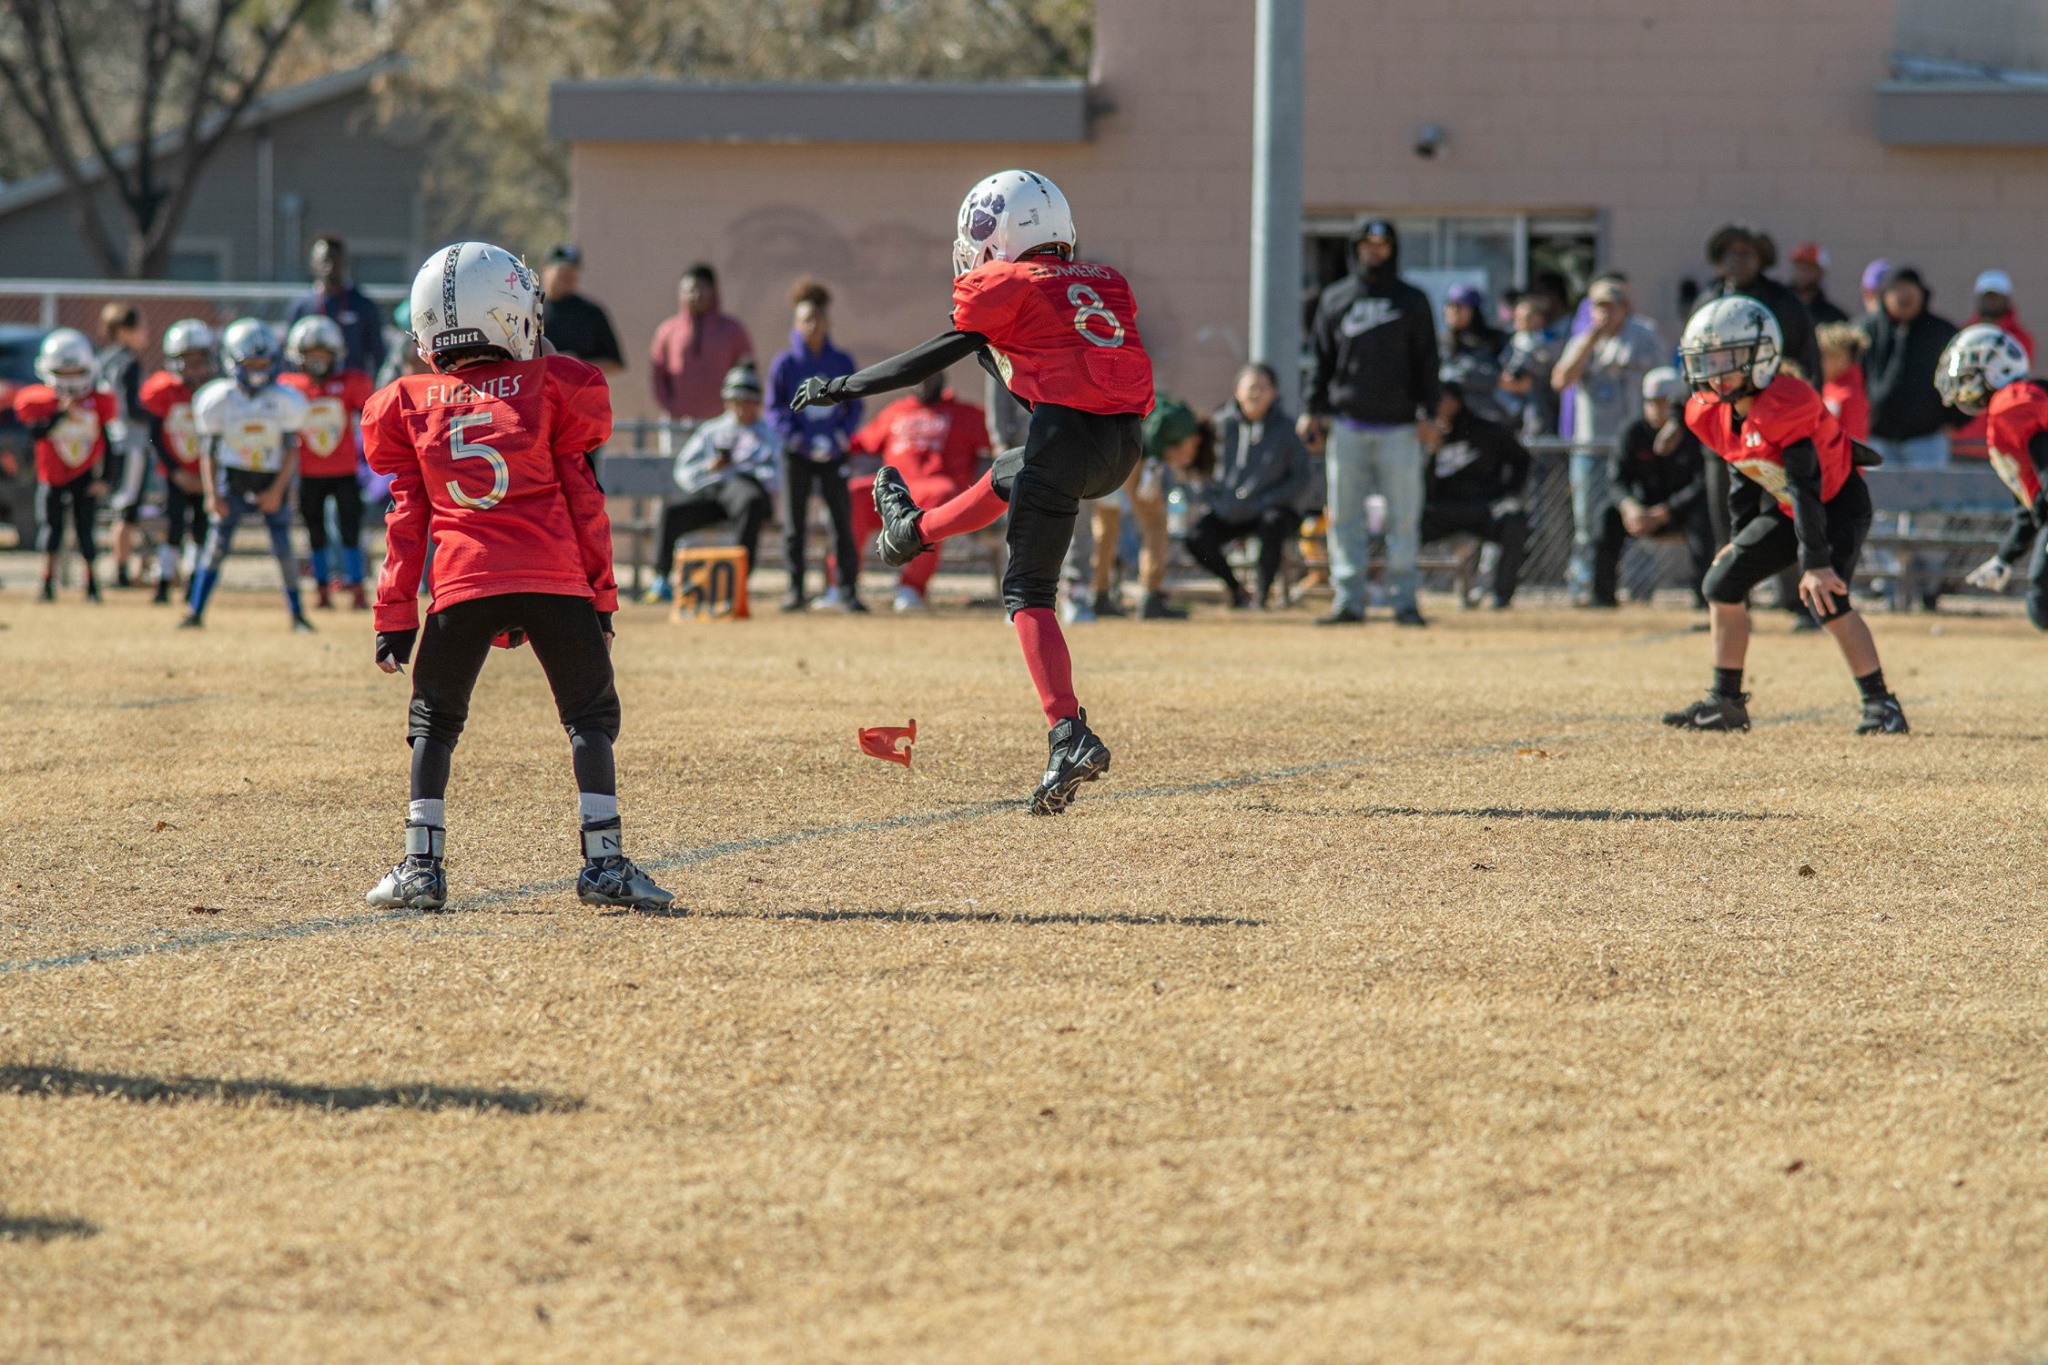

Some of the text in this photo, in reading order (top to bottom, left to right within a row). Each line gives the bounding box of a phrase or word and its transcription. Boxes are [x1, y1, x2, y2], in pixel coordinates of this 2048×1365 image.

[1067, 283, 1125, 348] 8
[426, 375, 523, 407] FUENTES
[445, 411, 509, 510] 5
[679, 560, 735, 619] 50
